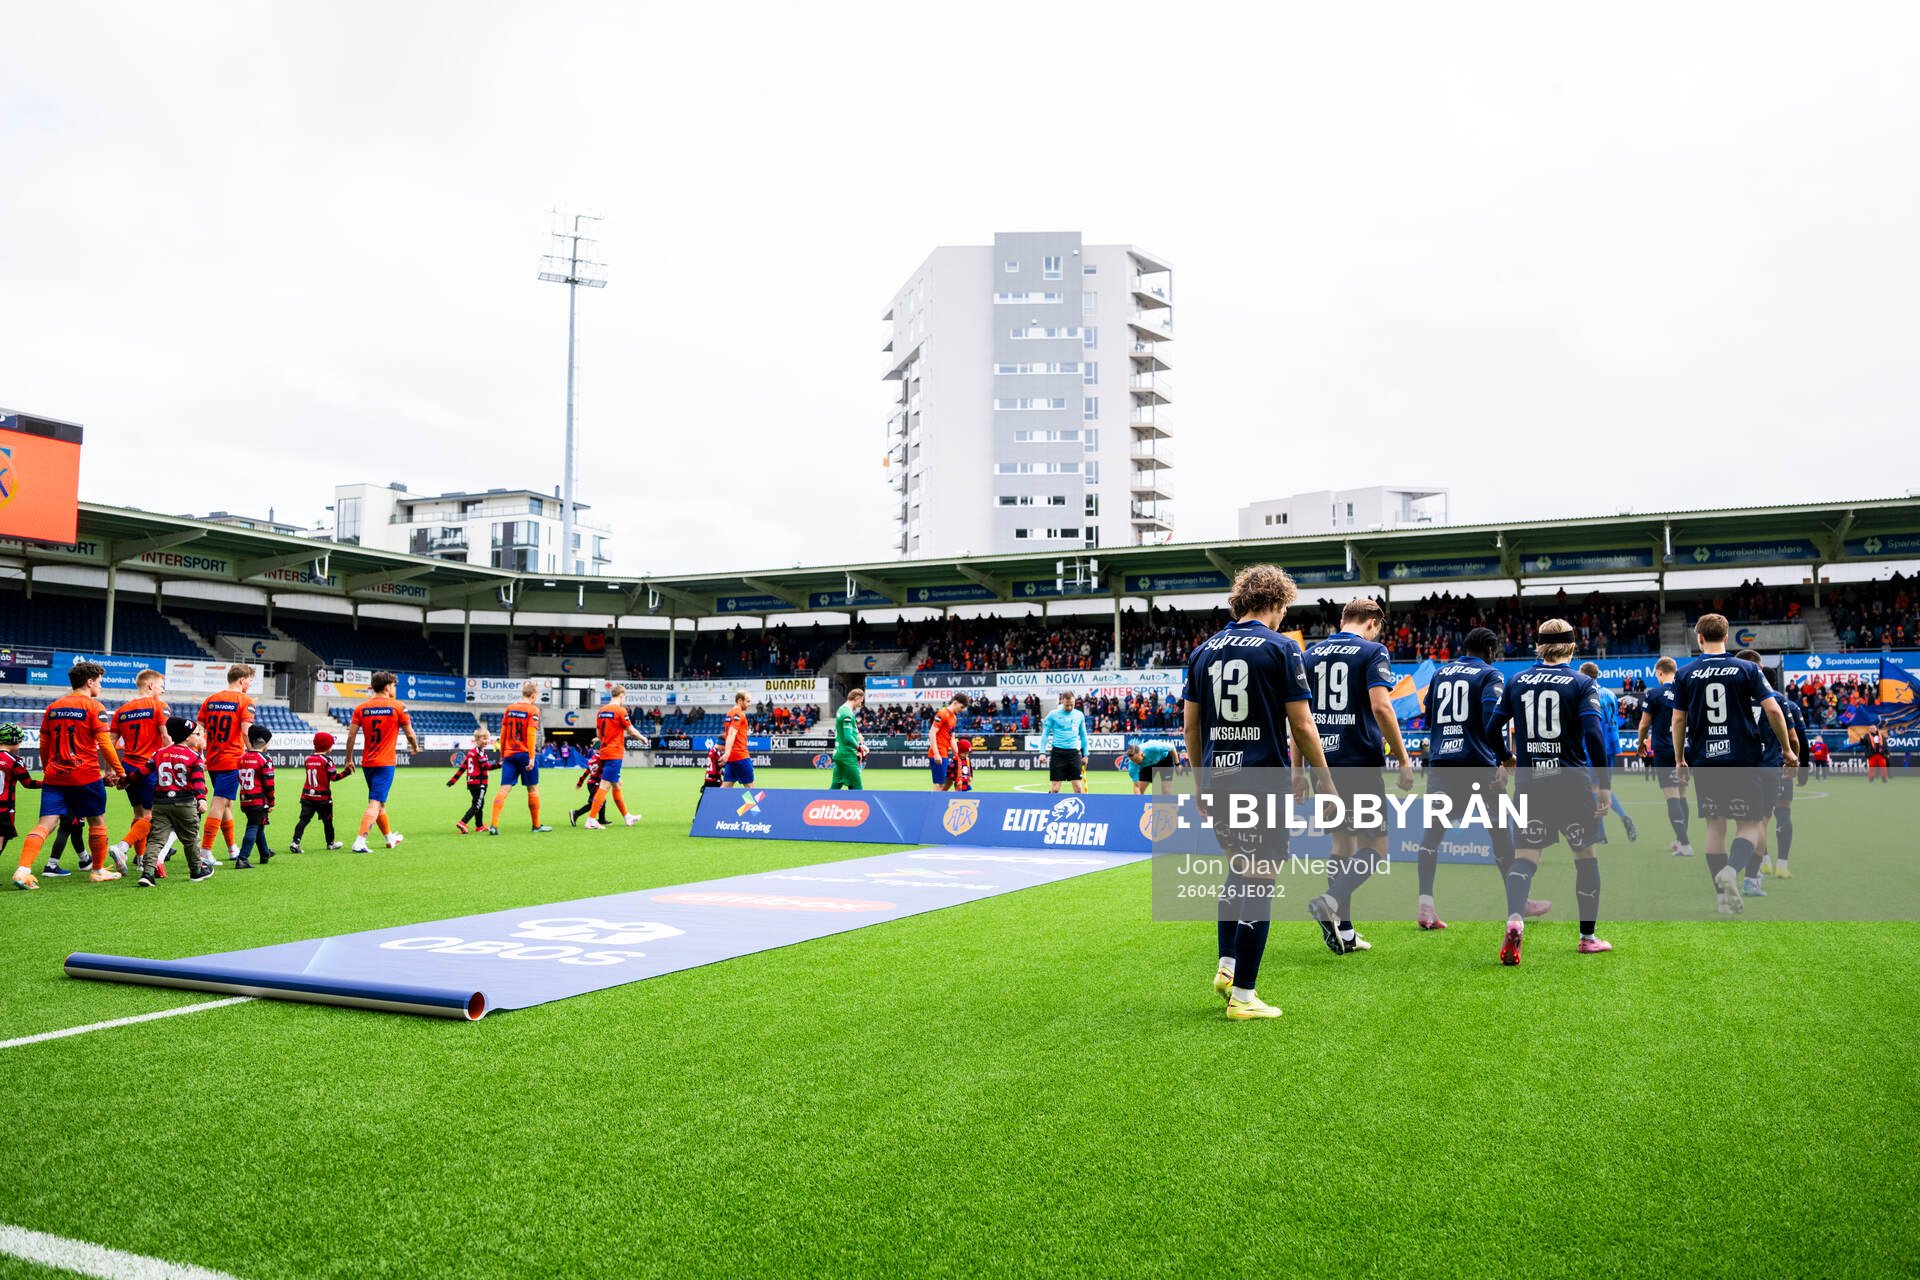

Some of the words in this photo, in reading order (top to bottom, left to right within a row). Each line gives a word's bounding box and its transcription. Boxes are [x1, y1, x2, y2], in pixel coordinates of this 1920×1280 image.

[365, 582, 428, 598] NTERSPORT
[481, 680, 522, 693] Bunker
[765, 680, 816, 694] BUNNPRIS
[1000, 674, 1038, 685] NOGVA
[1046, 673, 1085, 684] NOGVA
[1314, 661, 1349, 711] 19
[625, 695, 662, 703] ravel.no
[1207, 659, 1249, 722] 13
[1437, 680, 1470, 724] 20
[1705, 683, 1728, 724] 9
[1520, 690, 1562, 739] 10
[207, 714, 232, 742] 39
[370, 719, 382, 744] 5
[1708, 726, 1728, 735] KILEN
[53, 724, 76, 758] 11
[129, 723, 141, 751] 7
[1443, 738, 1464, 750] MOT
[1709, 739, 1730, 753] MOT
[902, 755, 930, 768] Lokale
[998, 756, 1016, 768] vær
[1018, 757, 1031, 771] og
[1214, 751, 1243, 768] MOT
[157, 761, 188, 787] 63
[808, 804, 864, 821] altibox
[1002, 808, 1051, 833] ELITE
[715, 820, 740, 832] Norsk
[741, 822, 772, 834] Tipping
[1043, 822, 1109, 847] SERIEN
[1441, 841, 1490, 858] Tipping
